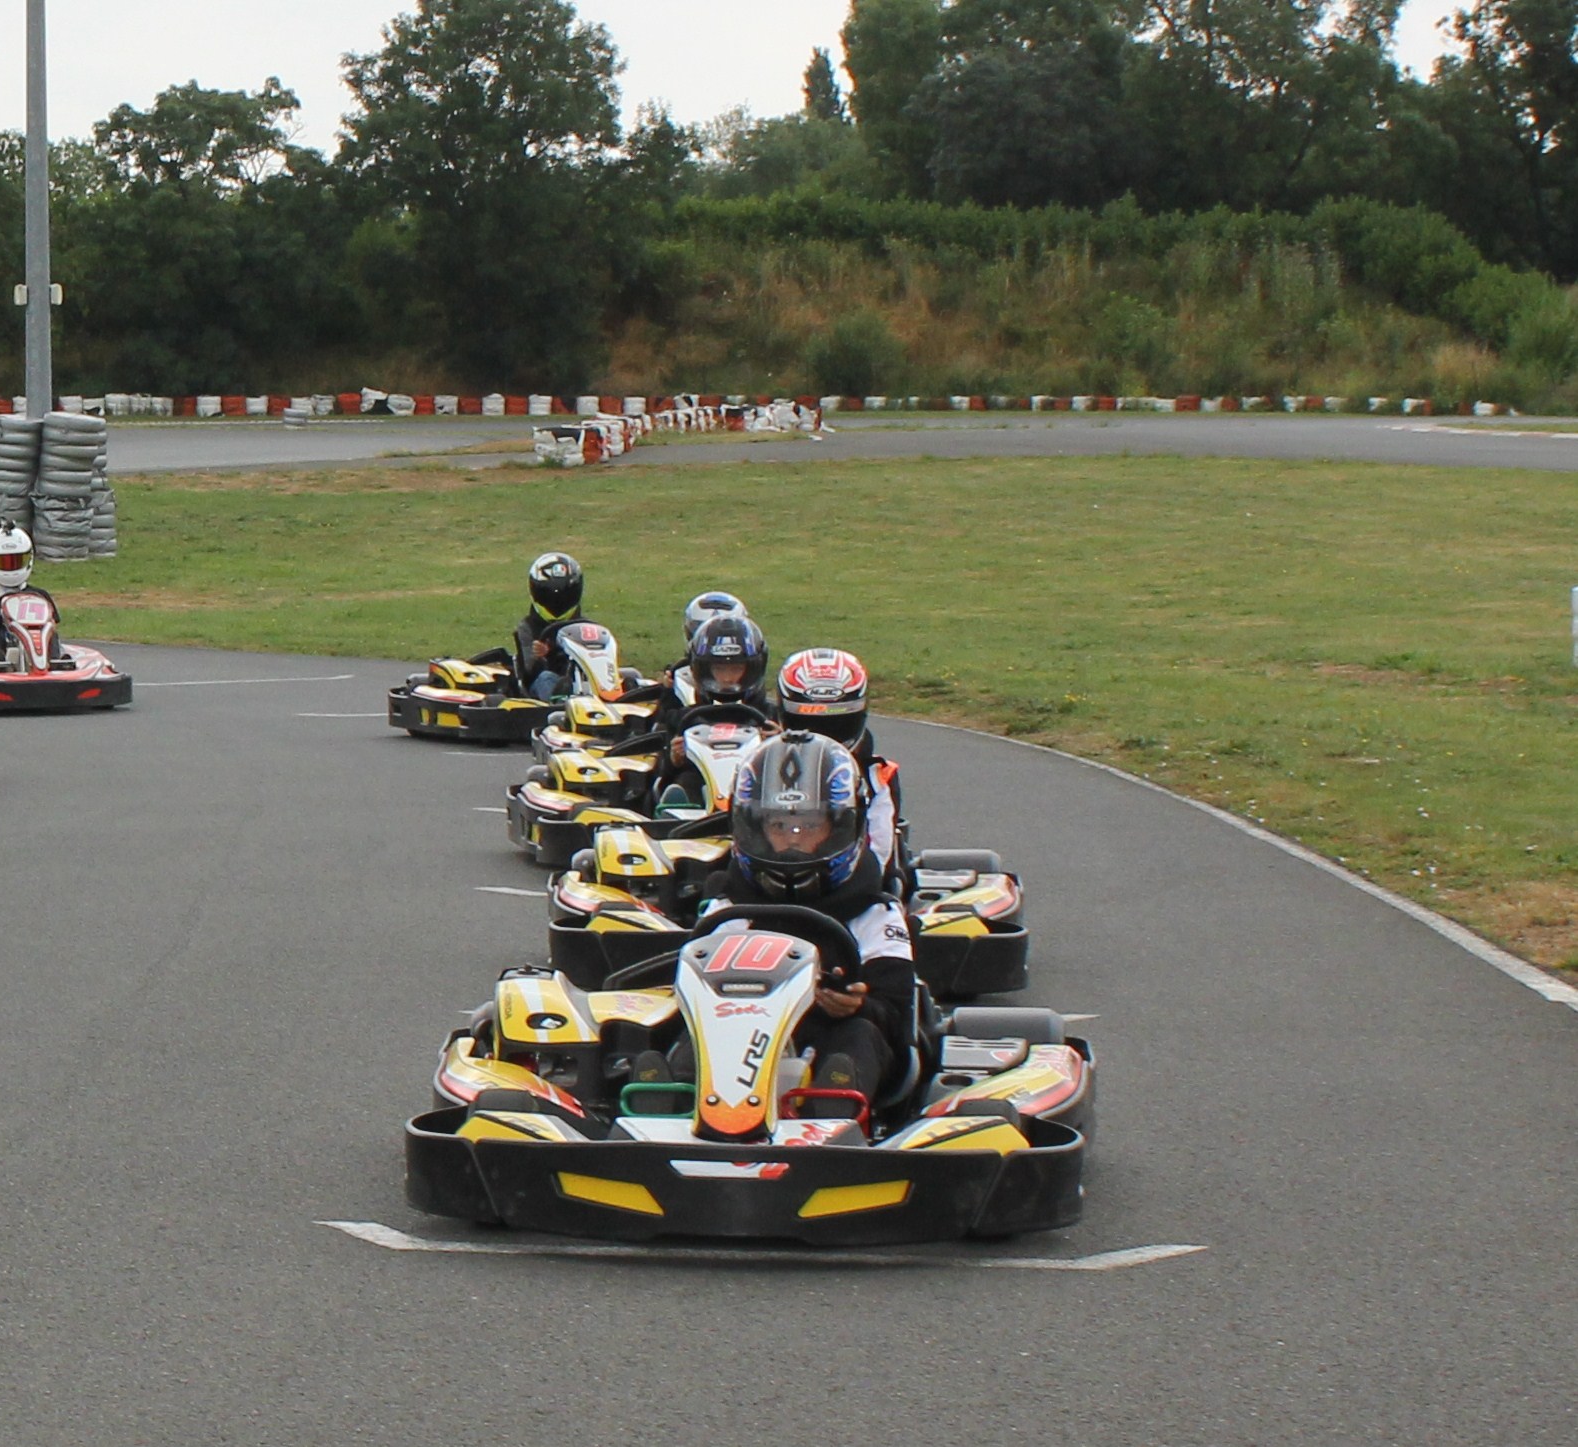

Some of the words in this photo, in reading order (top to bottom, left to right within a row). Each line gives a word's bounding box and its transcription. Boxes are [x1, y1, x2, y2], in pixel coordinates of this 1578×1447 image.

[810, 687, 839, 696] HJC
[703, 934, 794, 972] 10
[736, 1028, 770, 1089] LRS
